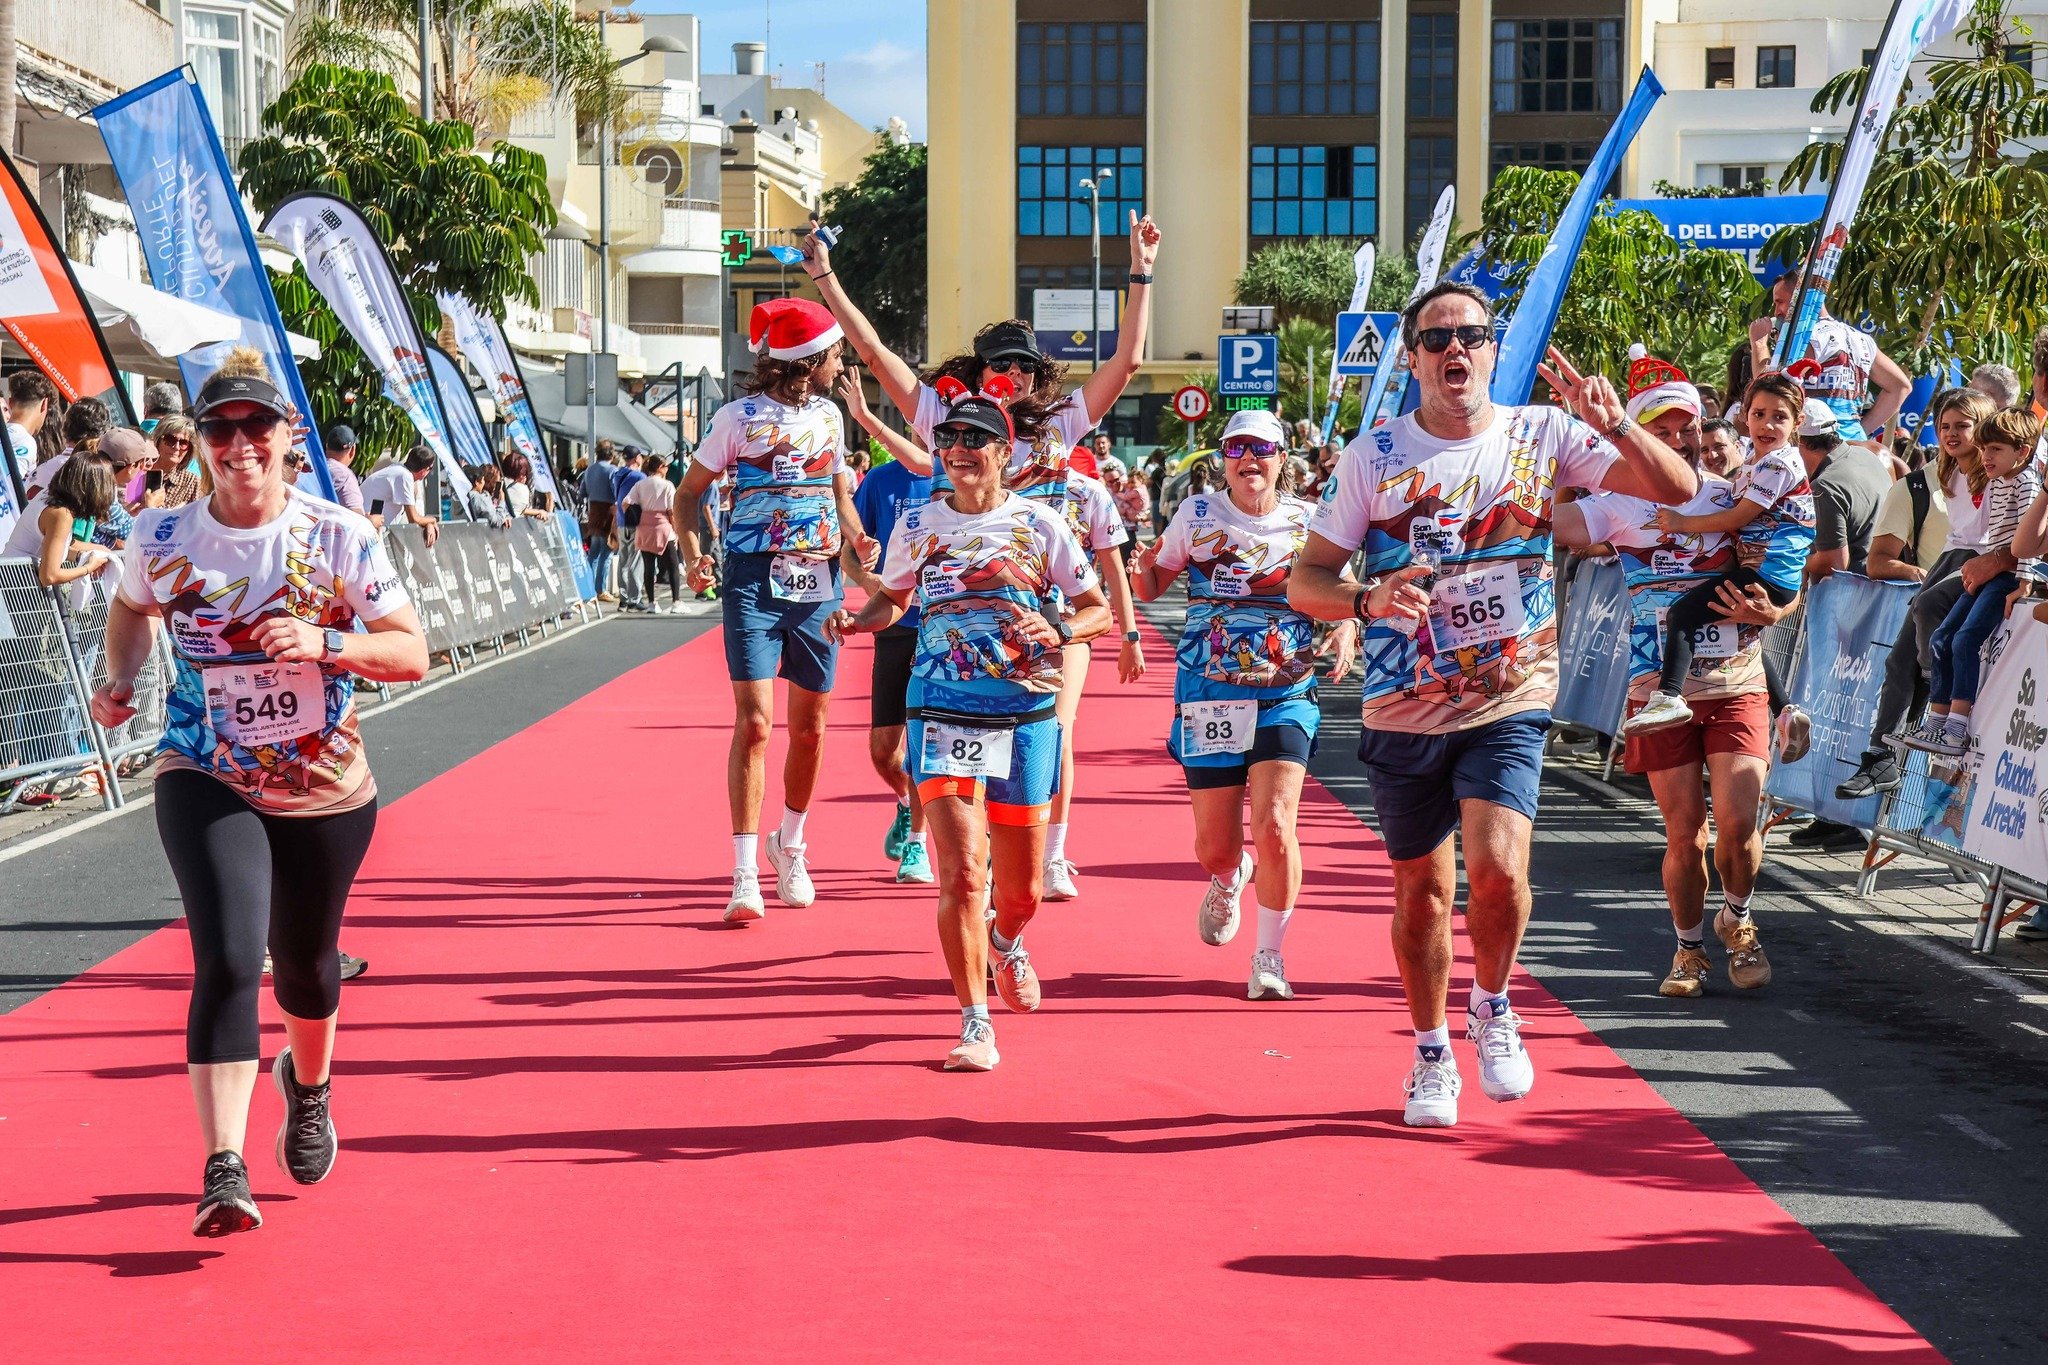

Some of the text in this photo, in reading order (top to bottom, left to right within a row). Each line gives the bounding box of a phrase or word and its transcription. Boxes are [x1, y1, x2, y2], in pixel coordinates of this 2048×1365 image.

[1678, 224, 1717, 240] DEL
[1233, 340, 1263, 379] P
[1224, 381, 1262, 390] CENTRO
[1226, 397, 1269, 411] LIBRE
[1413, 524, 1431, 532] San
[1414, 529, 1453, 541] Silvestre
[1215, 568, 1227, 576] San
[784, 574, 818, 590] 483
[924, 575, 953, 584] Silvestre
[1215, 575, 1242, 583] Silvestre
[925, 581, 950, 591] Ciudad
[1213, 581, 1237, 589] Ciudad
[928, 588, 955, 597] Arrecife
[1451, 594, 1505, 629] 565
[174, 619, 190, 630] San
[175, 627, 214, 639] Silvestre
[178, 636, 209, 647] Ciudad
[181, 643, 217, 654] Arrecife
[236, 690, 298, 725] 549
[1205, 720, 1233, 740] 83
[951, 738, 983, 762] 82
[1981, 790, 2027, 840] Arrecife
